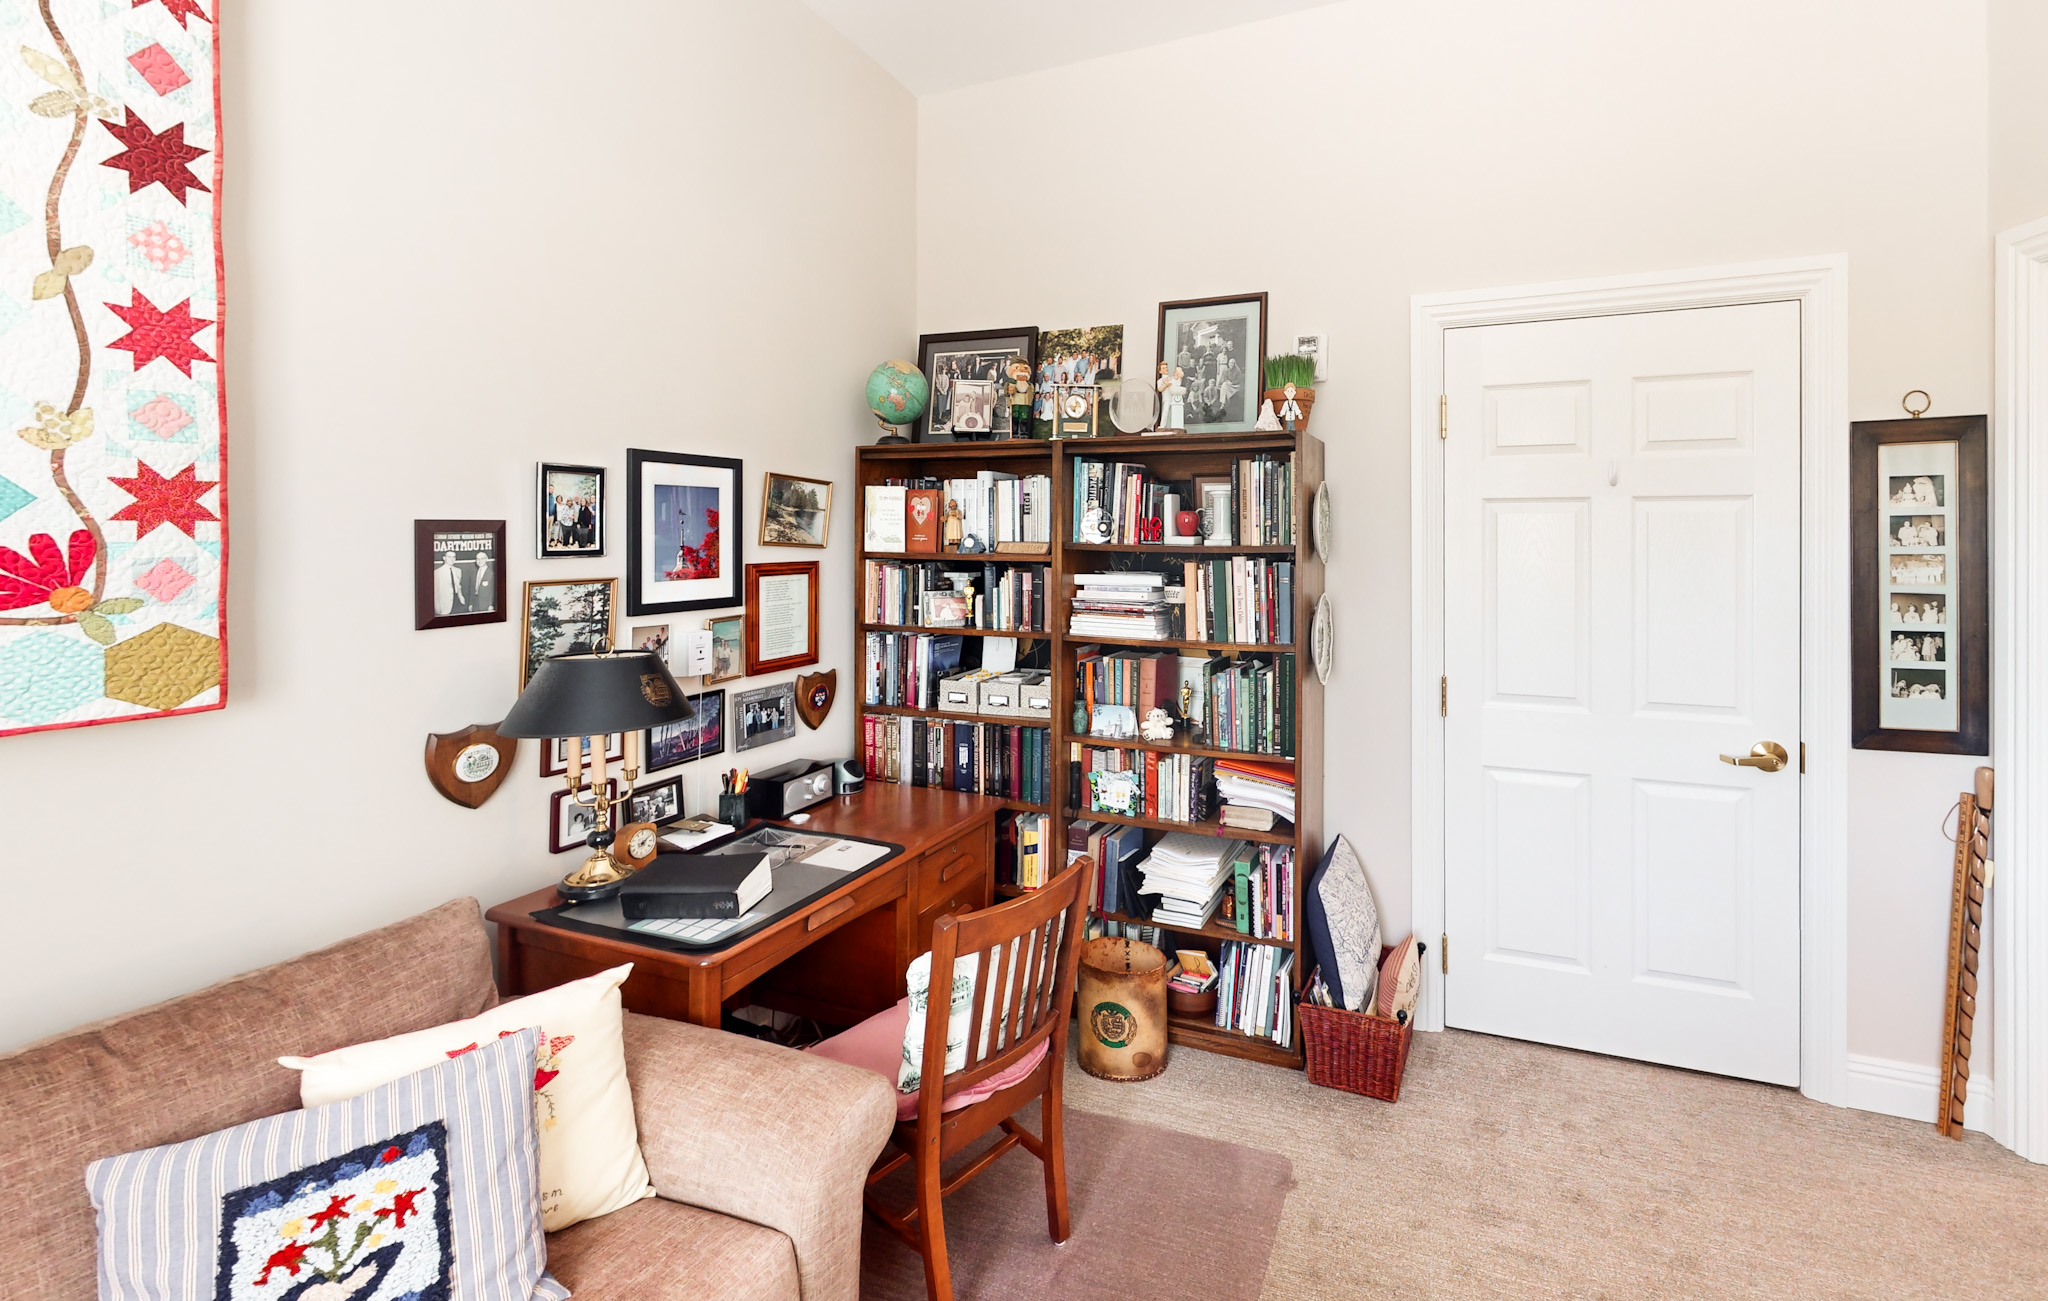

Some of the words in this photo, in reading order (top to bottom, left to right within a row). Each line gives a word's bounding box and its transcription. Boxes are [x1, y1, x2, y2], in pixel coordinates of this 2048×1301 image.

[1089, 477, 1097, 500] PACIFIC
[434, 540, 492, 551] DARTMOUTH
[1250, 694, 1254, 702] OF
